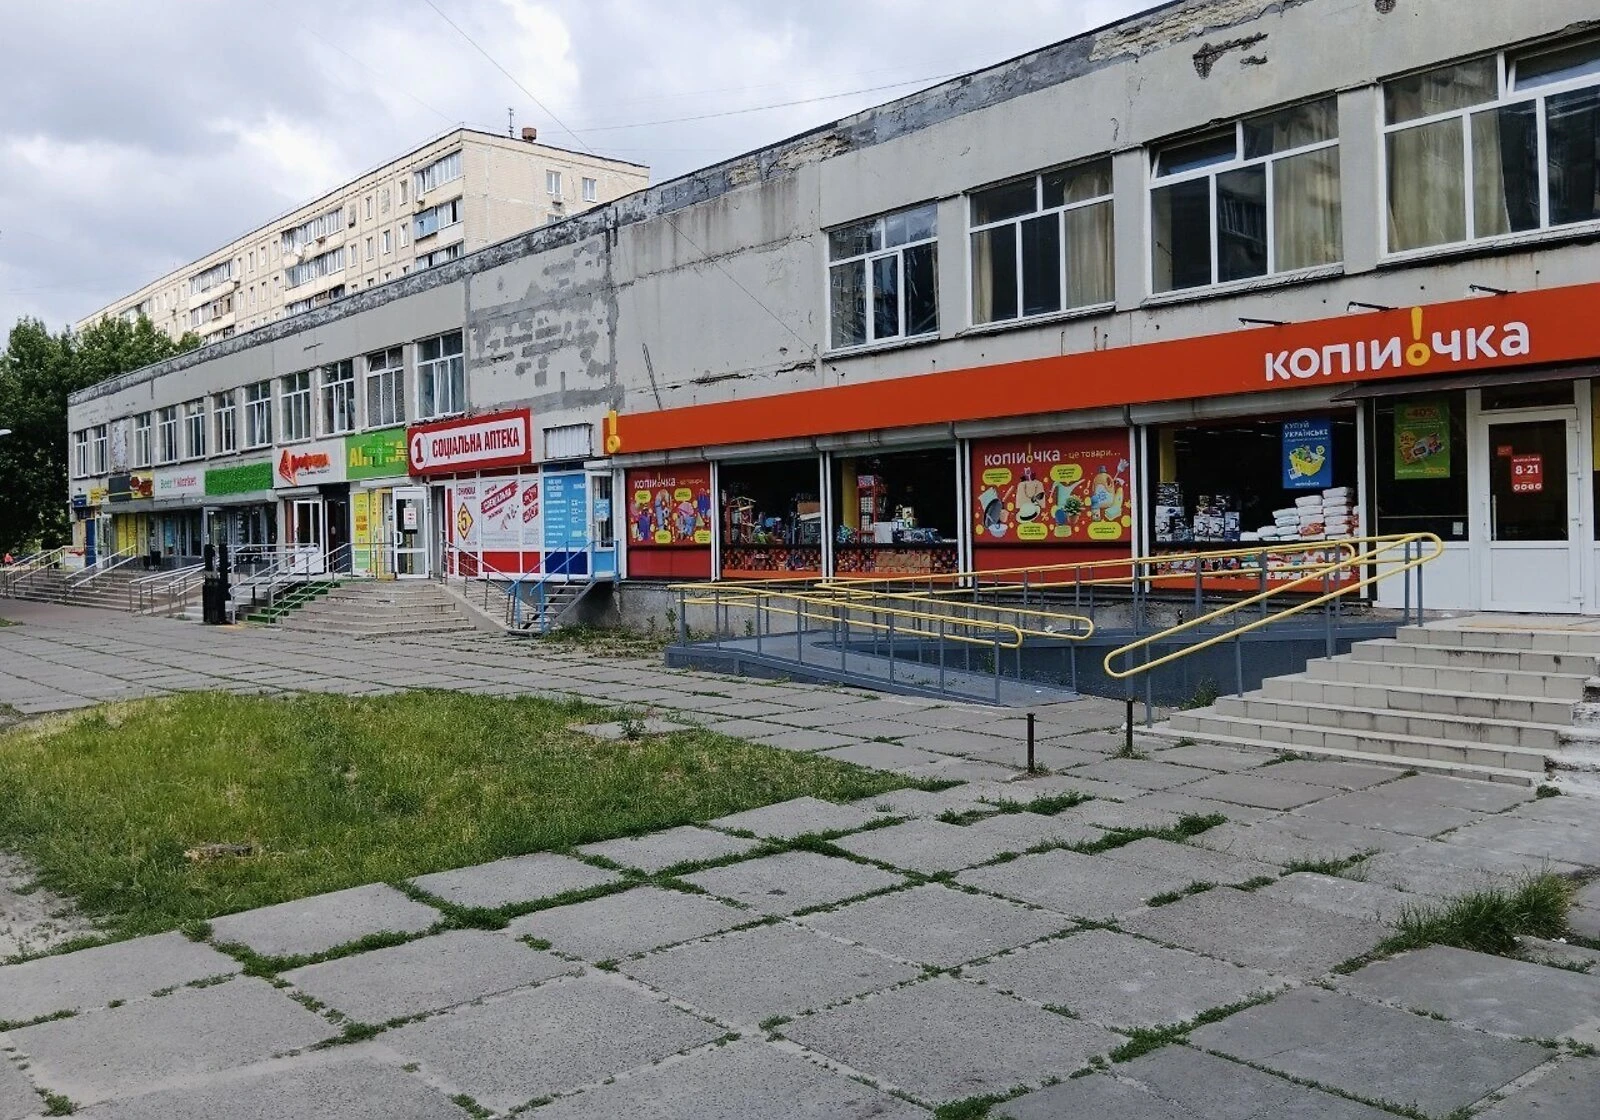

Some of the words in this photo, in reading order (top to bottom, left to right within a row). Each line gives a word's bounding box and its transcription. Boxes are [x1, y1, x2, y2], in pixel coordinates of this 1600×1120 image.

[1284, 428, 1329, 438] УКРАЇНСЬКЕ
[414, 437, 424, 463] 1
[432, 432, 482, 458] СОЦІАЛЬНА
[484, 427, 520, 450] АПТЕКА
[1068, 451, 1080, 460] це
